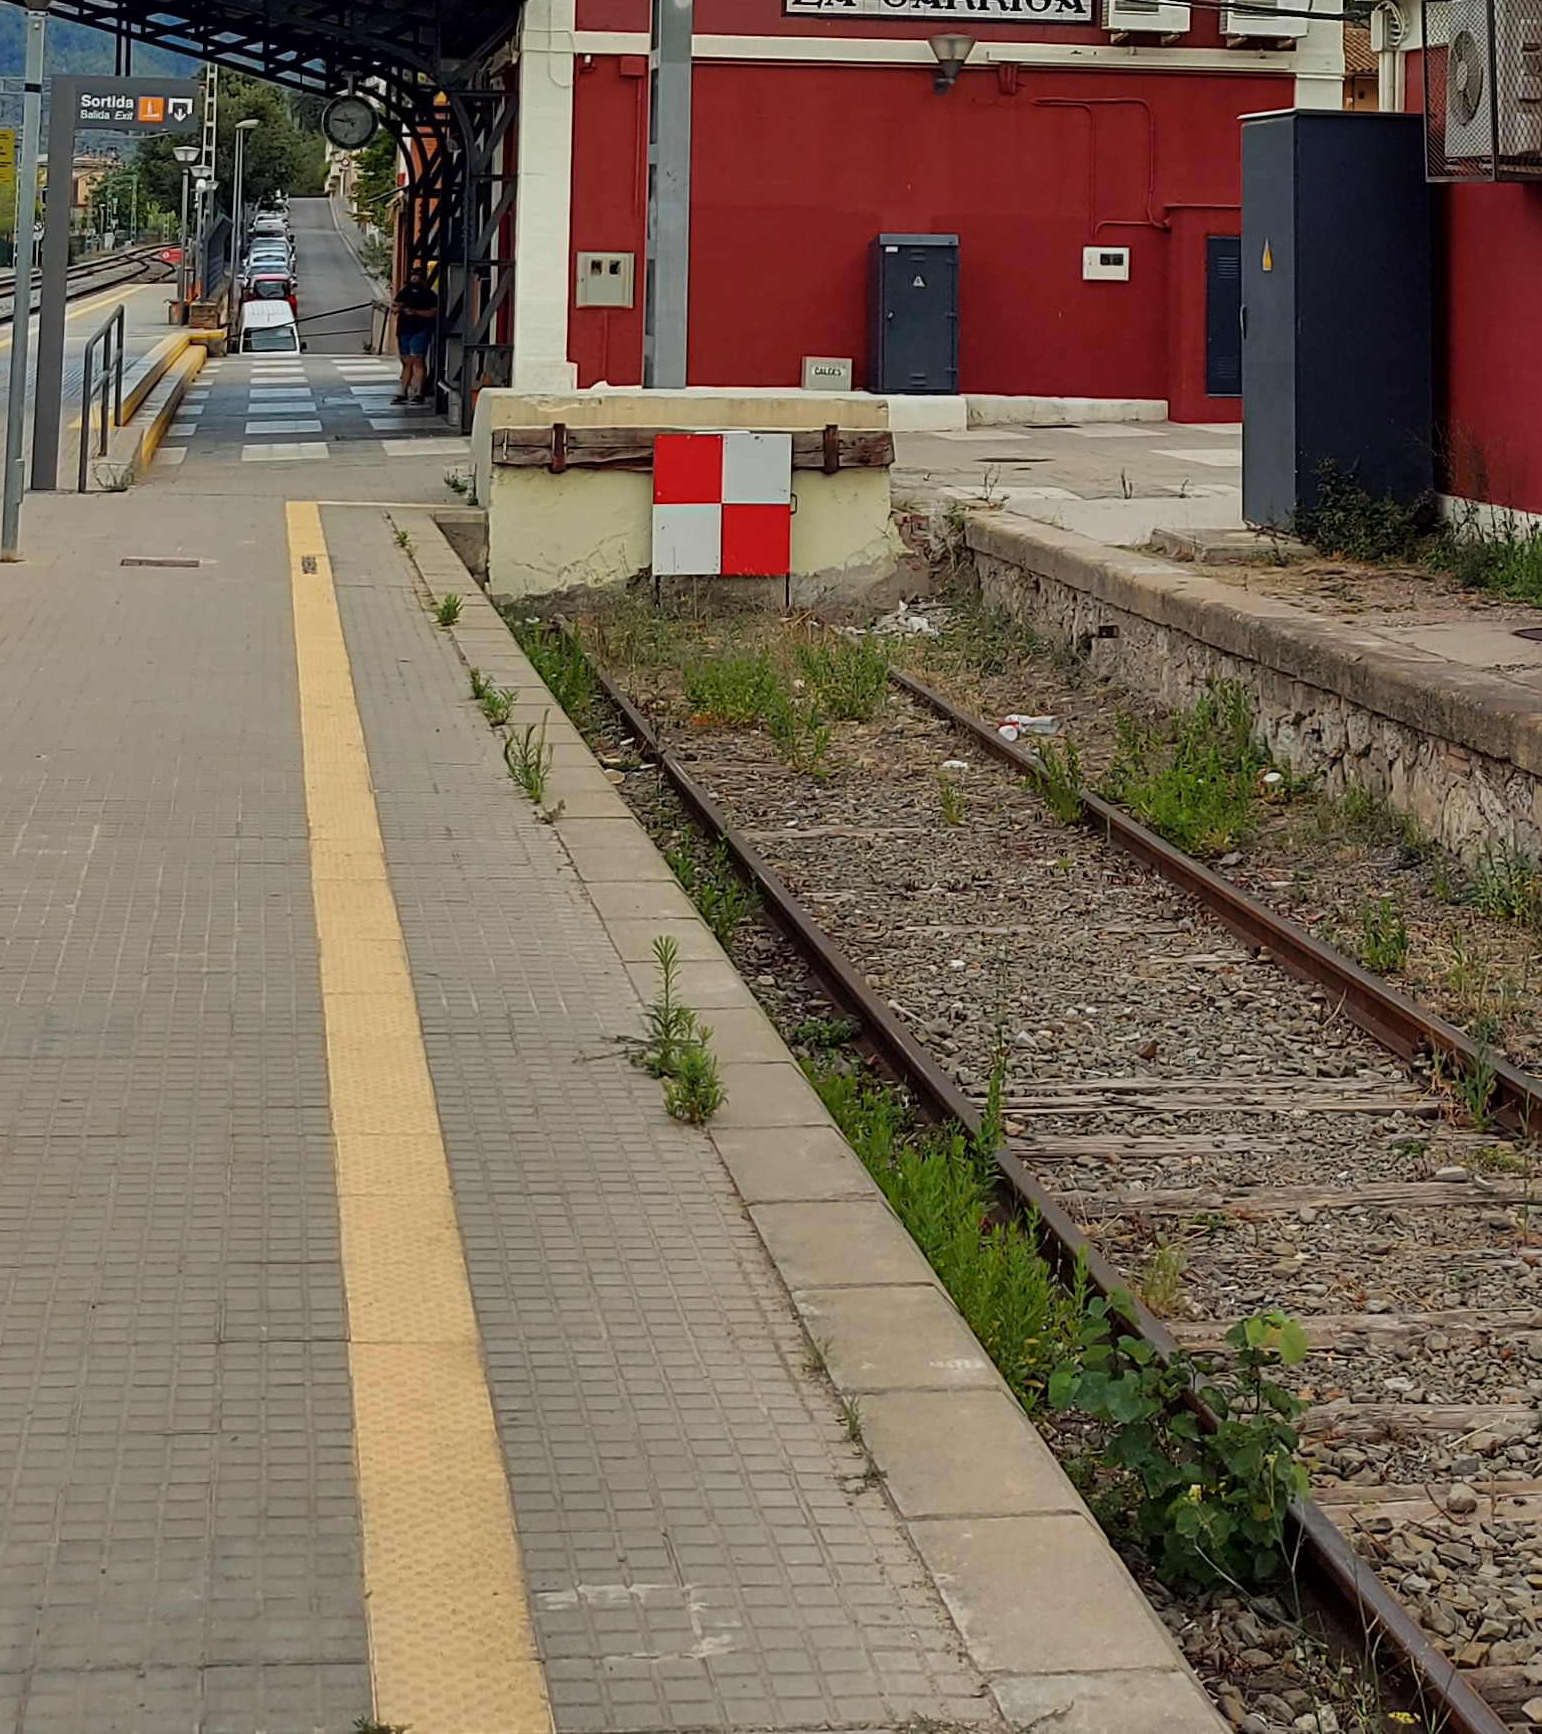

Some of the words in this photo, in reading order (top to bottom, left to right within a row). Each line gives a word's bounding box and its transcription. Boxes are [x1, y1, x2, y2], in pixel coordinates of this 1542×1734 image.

[80, 93, 134, 109] Sortida
[80, 109, 110, 120] Salida
[114, 110, 134, 121] Exit
